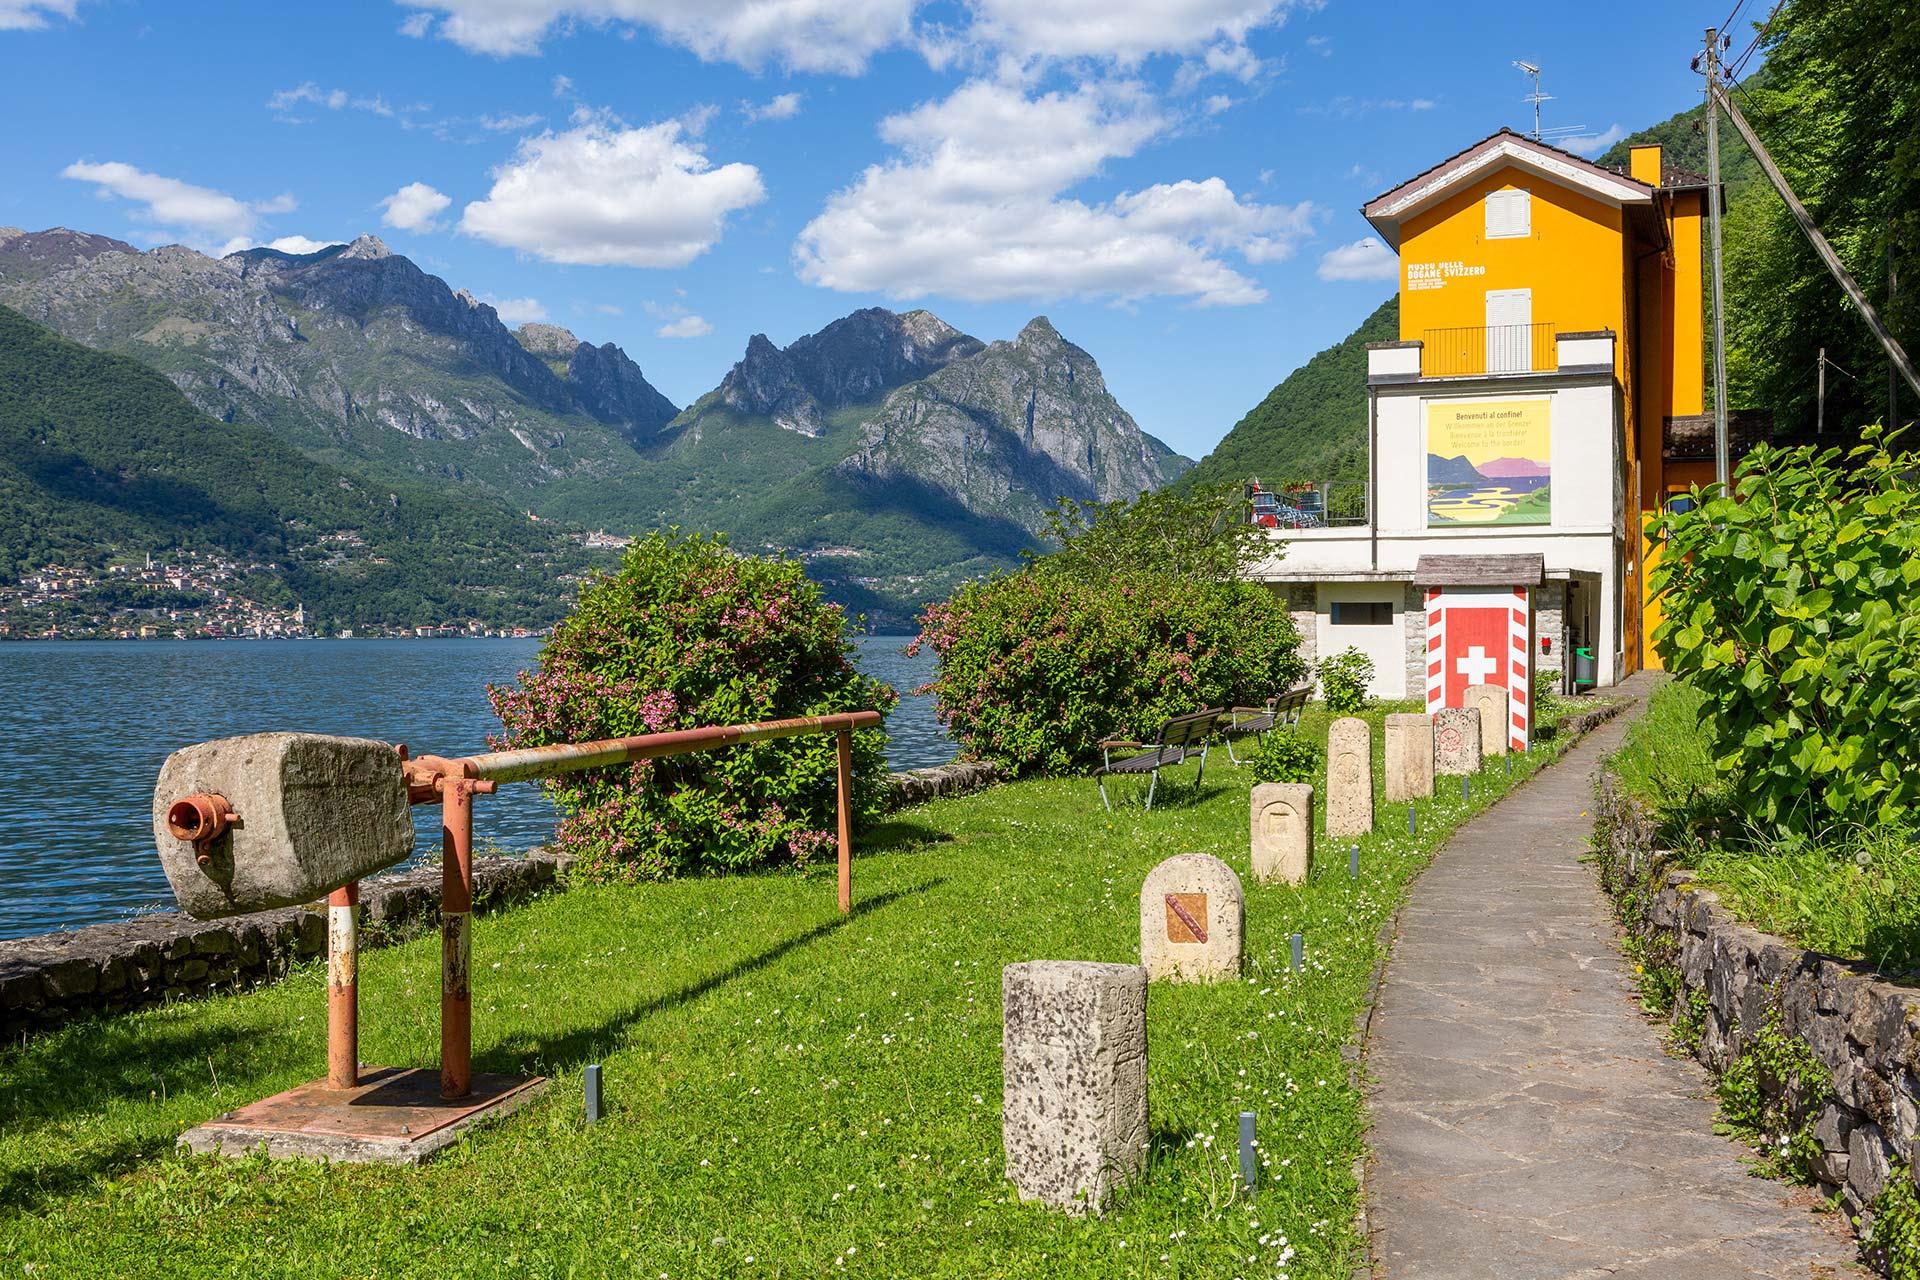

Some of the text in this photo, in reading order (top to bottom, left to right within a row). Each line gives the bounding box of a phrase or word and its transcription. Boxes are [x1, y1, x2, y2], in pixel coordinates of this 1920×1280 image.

[1408, 266, 1485, 279] DOGANE SVIZZERO
[1456, 410, 1523, 421] Benvenuti al confine!
